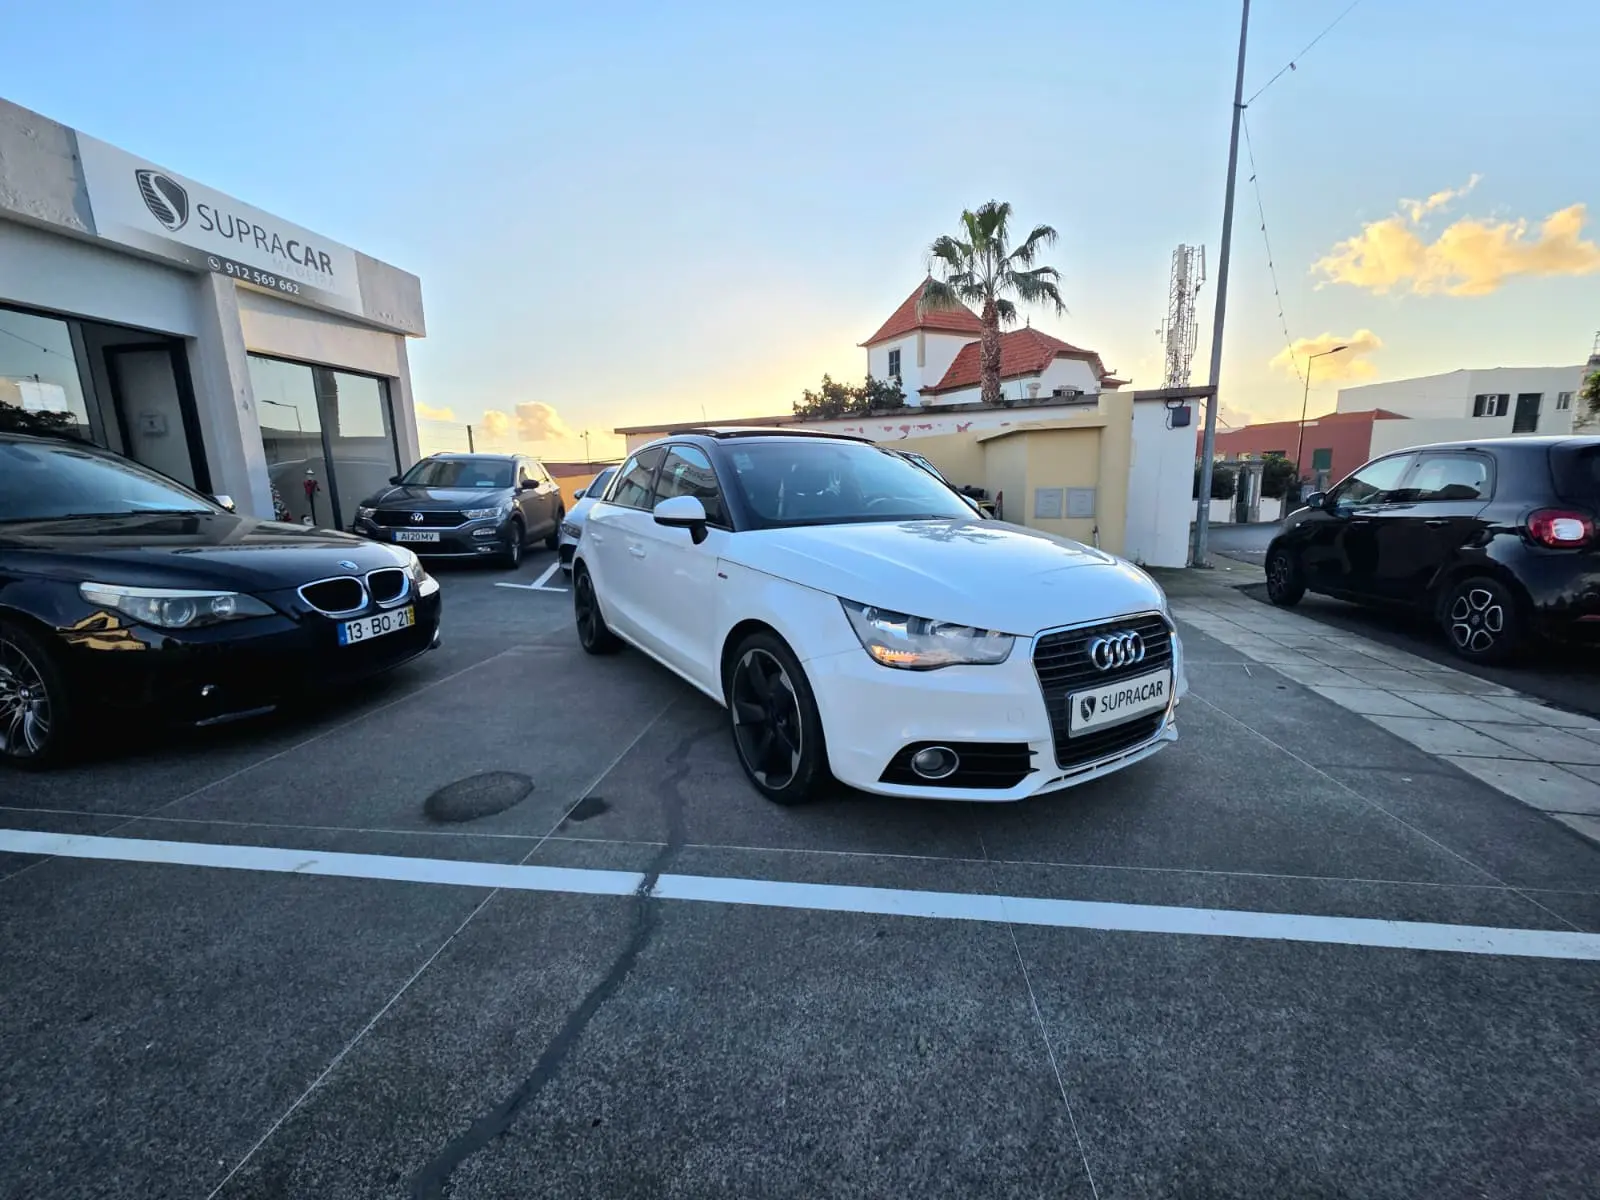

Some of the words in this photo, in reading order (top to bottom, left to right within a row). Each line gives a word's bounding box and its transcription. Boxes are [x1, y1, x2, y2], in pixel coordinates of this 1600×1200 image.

[197, 203, 334, 275] SUPRACAR
[225, 262, 250, 280] 912
[254, 271, 276, 287] 569
[279, 280, 300, 295] 662
[1100, 680, 1163, 713] SUPRACAR
